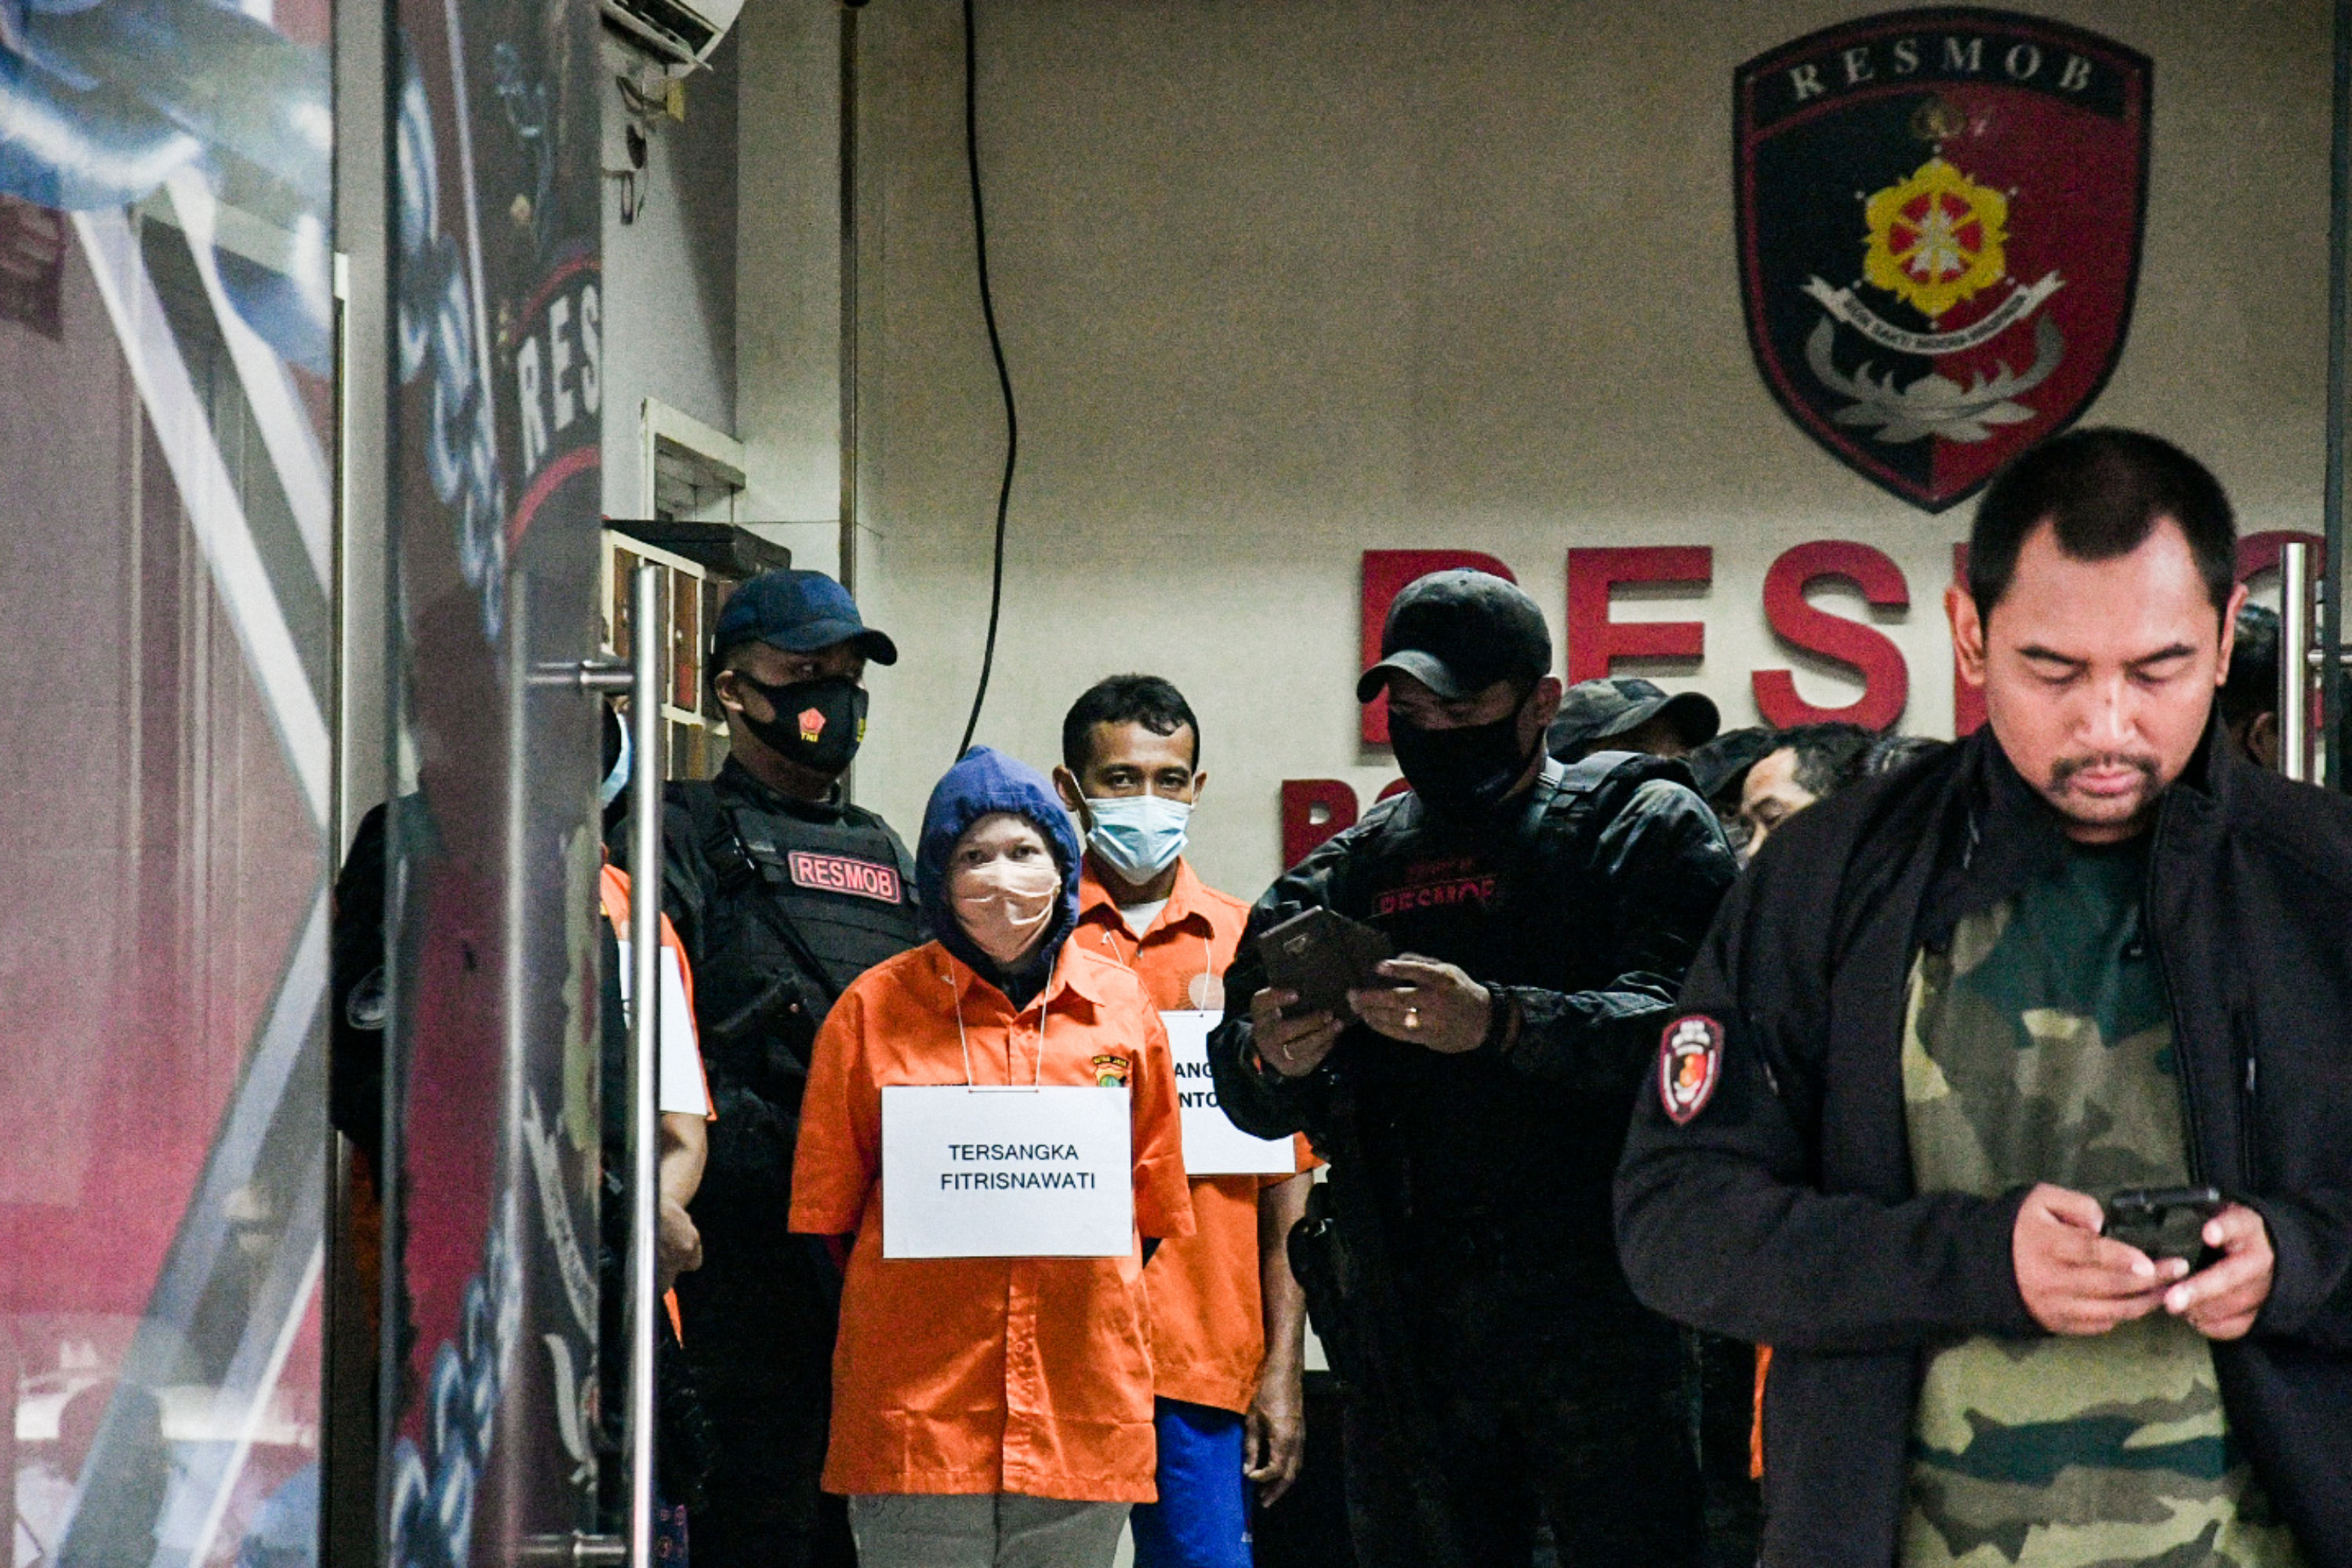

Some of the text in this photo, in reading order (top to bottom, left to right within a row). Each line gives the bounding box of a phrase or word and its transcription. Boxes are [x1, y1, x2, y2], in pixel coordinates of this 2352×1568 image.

[1790, 37, 2092, 101] RESMOB
[517, 284, 599, 477] RES
[797, 858, 893, 897] RESMOB
[949, 1145, 1079, 1160] TERSANGKA
[940, 1173, 1094, 1189] FITRISNAWATI
